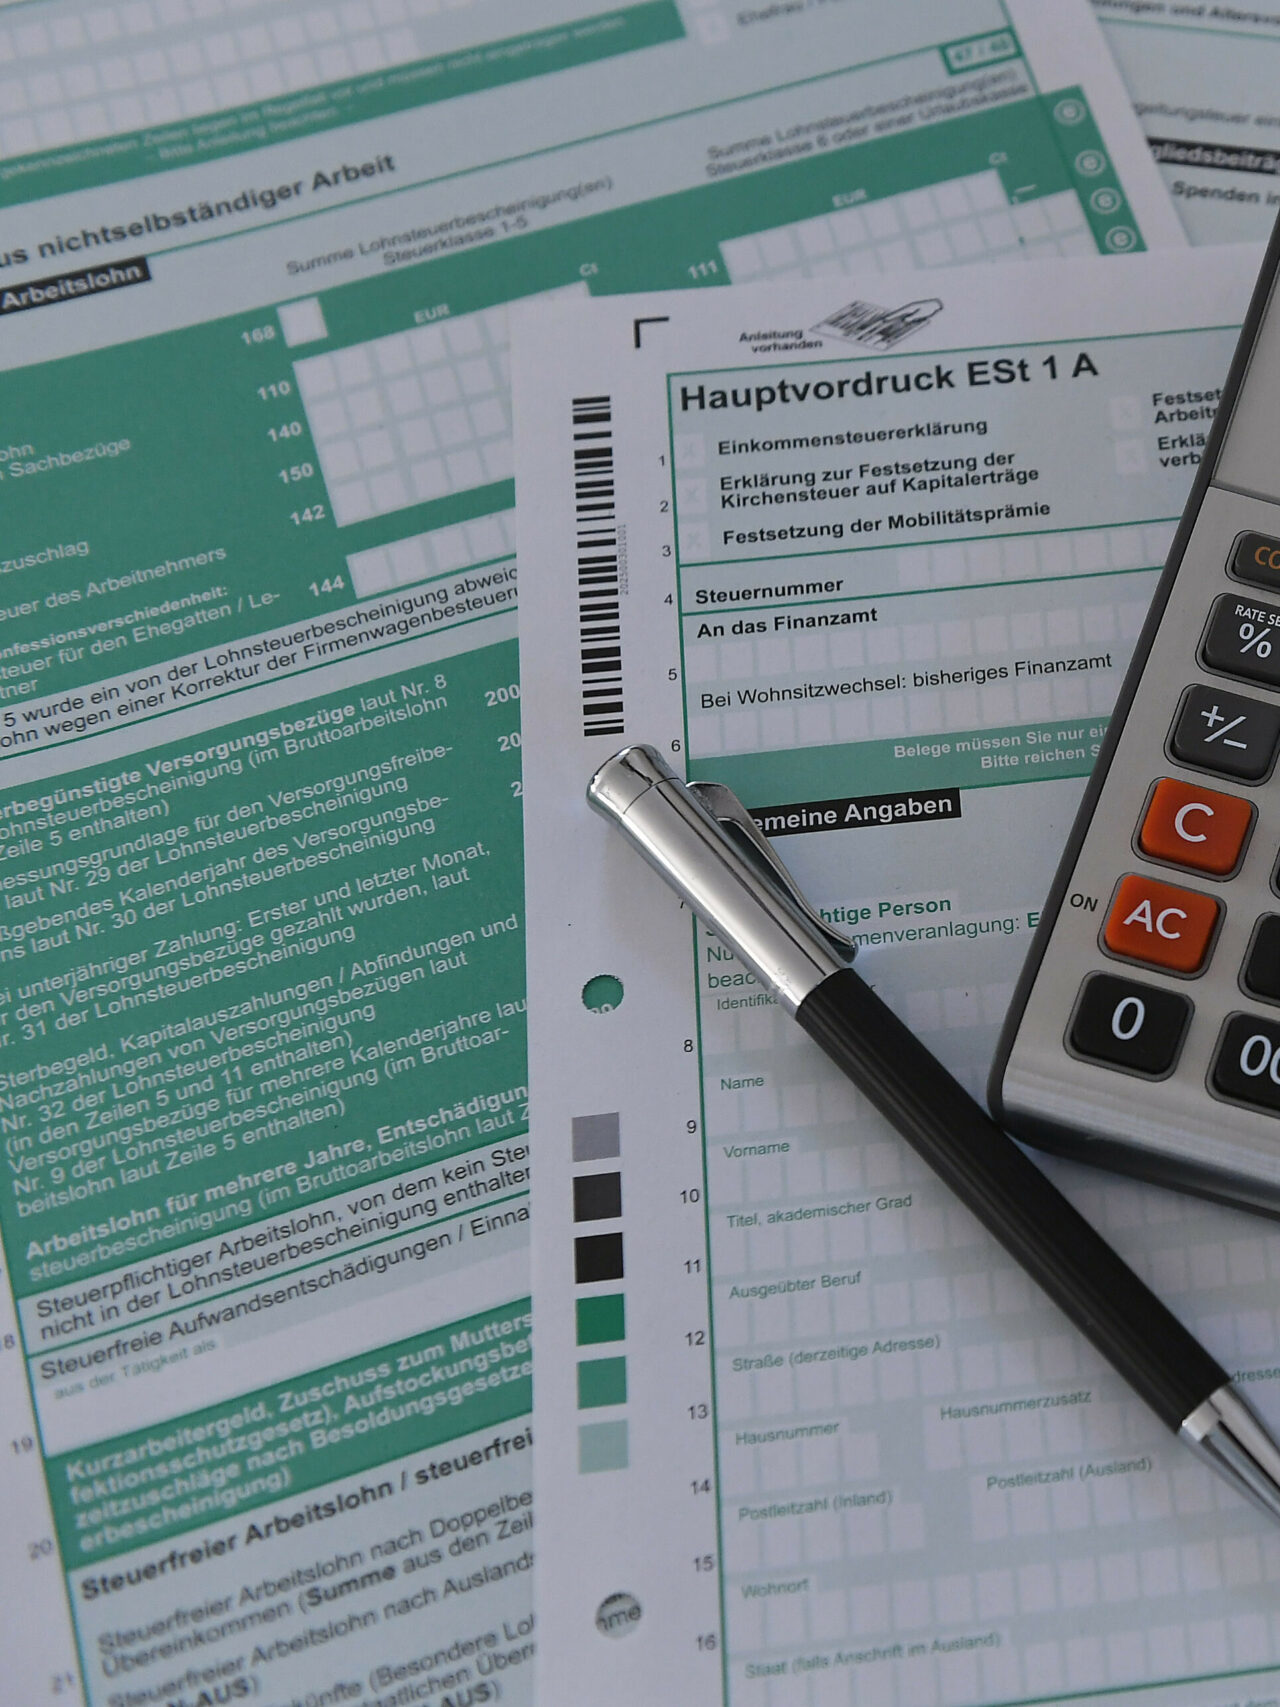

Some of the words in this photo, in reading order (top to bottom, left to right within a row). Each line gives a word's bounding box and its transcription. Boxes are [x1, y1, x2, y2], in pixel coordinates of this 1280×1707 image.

[38, 181, 301, 258] nichtselbständiger
[312, 155, 395, 190] Arbeit
[2, 266, 141, 308] Arbeitslohn
[242, 325, 275, 344] 168
[257, 380, 290, 399] 110
[680, 364, 955, 412] Hauptvordruck
[967, 358, 1030, 386] ESt
[1042, 354, 1057, 379] 1
[1071, 352, 1098, 377] A
[268, 421, 301, 441] 140
[718, 421, 987, 455] Einkommensteuererklärung
[8, 438, 130, 477] Sachbezüge
[659, 455, 665, 467] 1
[720, 472, 815, 490] Erklärung
[822, 468, 852, 481] zur
[859, 457, 977, 478] Festsetzung
[983, 452, 1014, 466] der
[721, 485, 859, 508] Kirchensteuer
[866, 478, 896, 495] auf
[902, 468, 1038, 493] Kapitalerträge
[290, 504, 325, 524] 142
[660, 500, 669, 513] 2
[723, 523, 843, 545] Festsetzung
[850, 518, 882, 533] der
[888, 501, 1050, 529] Mobilitätsprämie
[662, 544, 672, 558] 3
[309, 574, 344, 596] 144
[695, 579, 843, 604] Steuernummer
[697, 623, 724, 638] An
[731, 619, 767, 635] das
[774, 607, 877, 630] Finanzamt
[1234, 602, 1267, 627] RATE
[1239, 623, 1273, 659] %
[3, 711, 16, 727] 5
[21, 697, 84, 722] wurde
[90, 686, 120, 704] ein
[124, 674, 161, 693] von
[167, 662, 197, 681] der
[203, 588, 448, 670] Lohnsteuerbescheinigung
[668, 668, 678, 681] 5
[701, 691, 730, 708] Bei
[736, 673, 906, 704] Wohnsitzwechsel:
[913, 666, 1008, 686] bisheriges
[1014, 653, 1112, 676] Finanzamt
[145, 704, 355, 776] Versorgungsbezüge
[359, 689, 397, 711] laut
[400, 682, 428, 699] Nr.
[434, 674, 446, 689] 8
[248, 747, 279, 768] (im
[283, 696, 447, 754] Bruttoarbeitslohn
[671, 739, 681, 753] 6
[893, 743, 950, 758] Belege
[955, 735, 1021, 752] müssen
[1026, 730, 1051, 744] Sie
[1057, 729, 1084, 740] nur
[844, 797, 951, 822] Angaben
[1175, 803, 1214, 842] C
[84, 866, 111, 886] 29
[116, 856, 149, 876] der
[155, 776, 408, 864] Lohnsteuerbescheinigung
[878, 899, 951, 917] Person
[1069, 891, 1099, 913] ON
[1123, 900, 1187, 939] AC
[1112, 997, 1144, 1039] 0
[683, 1039, 694, 1053] 8
[720, 1076, 764, 1090] Name
[723, 1142, 790, 1158] Vorname
[26, 1206, 160, 1259] Arbeitslohn
[166, 1193, 198, 1213] für
[204, 1161, 296, 1201] mehrere
[679, 1188, 700, 1204] 10
[767, 1201, 871, 1223] akademischer
[875, 1192, 912, 1210] Grad
[685, 1330, 705, 1346] 12
